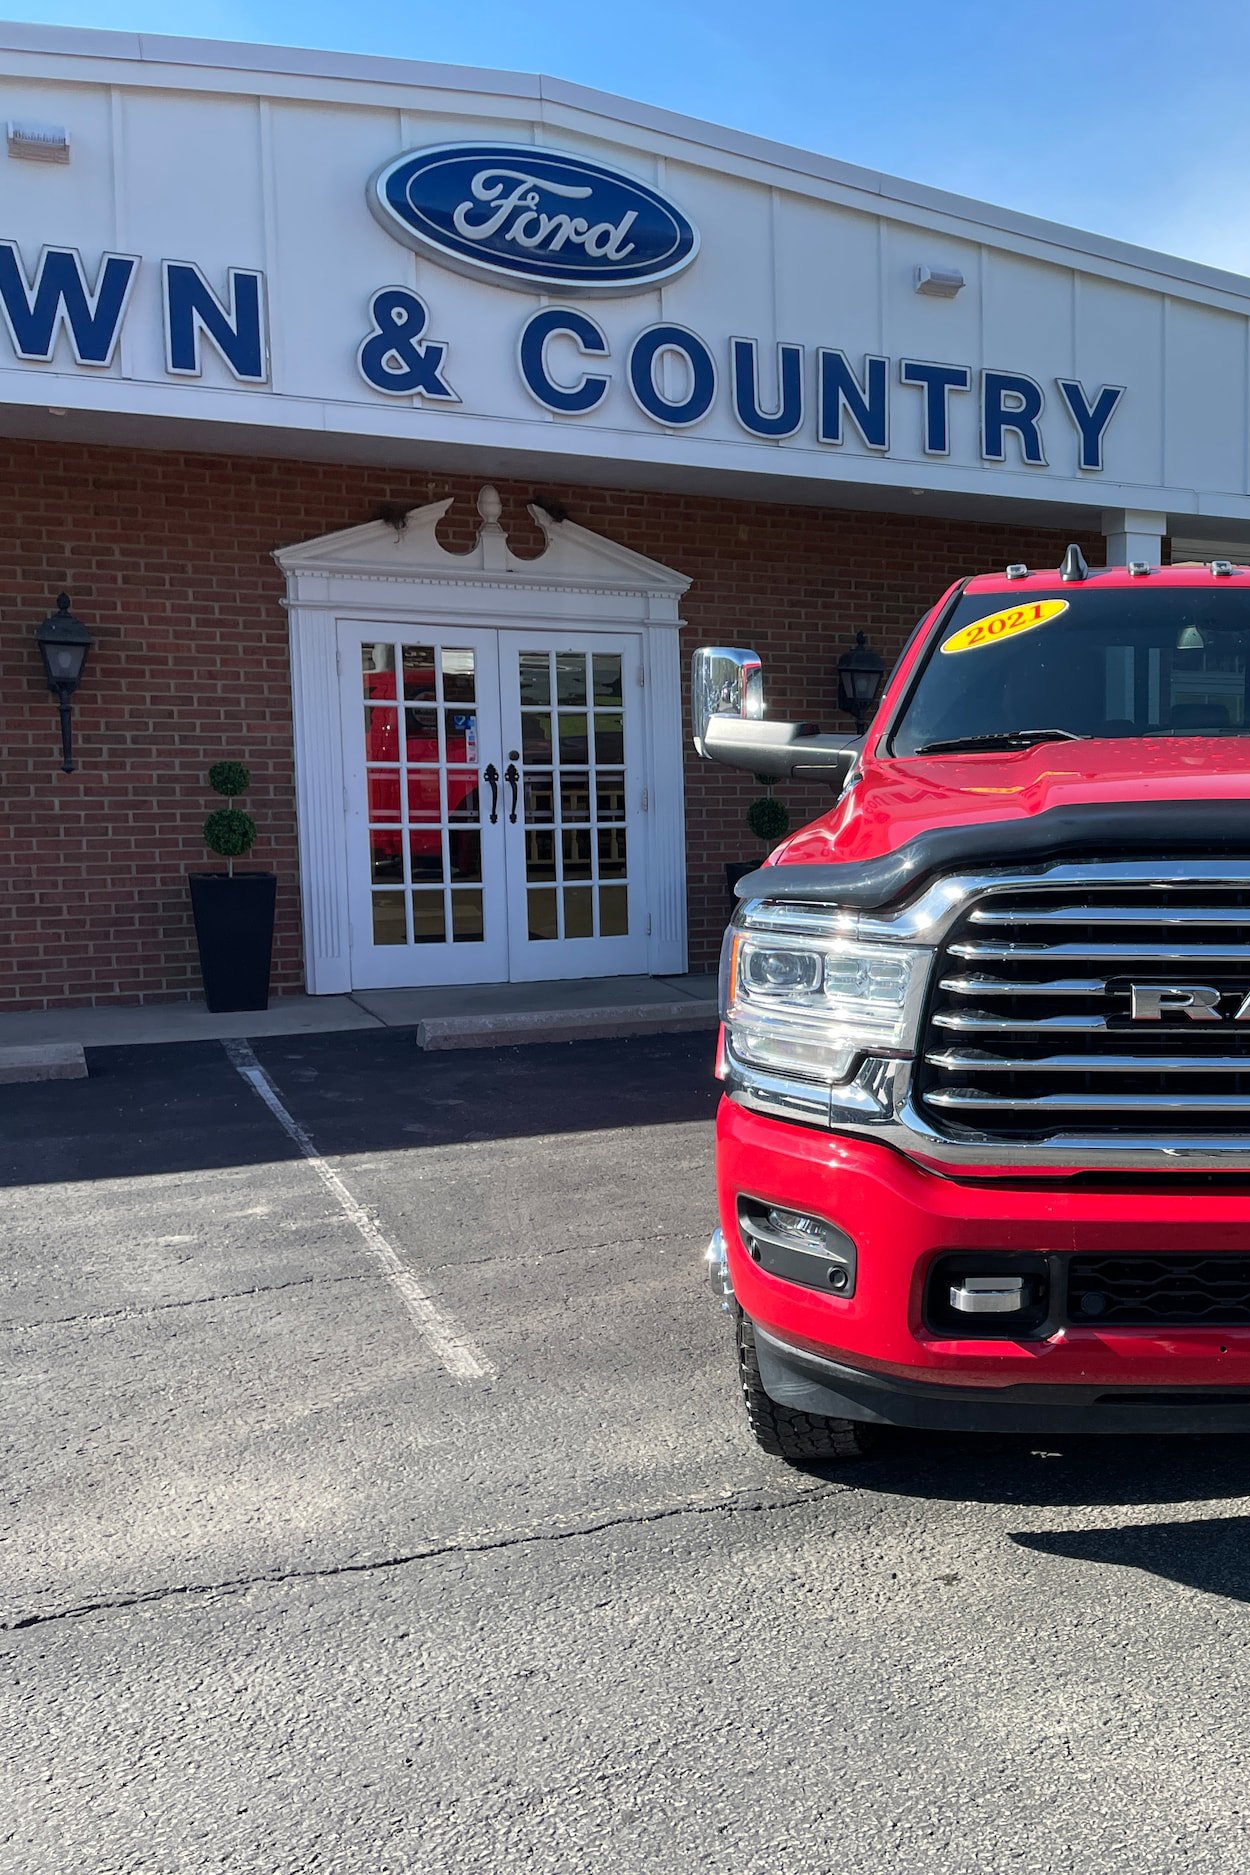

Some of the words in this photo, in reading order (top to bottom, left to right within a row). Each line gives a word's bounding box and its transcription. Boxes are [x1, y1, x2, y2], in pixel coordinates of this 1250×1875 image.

[452, 168, 639, 261] Ford
[357, 284, 462, 403] &
[516, 305, 1127, 472] COUNTRY
[966, 604, 1046, 646] 2021
